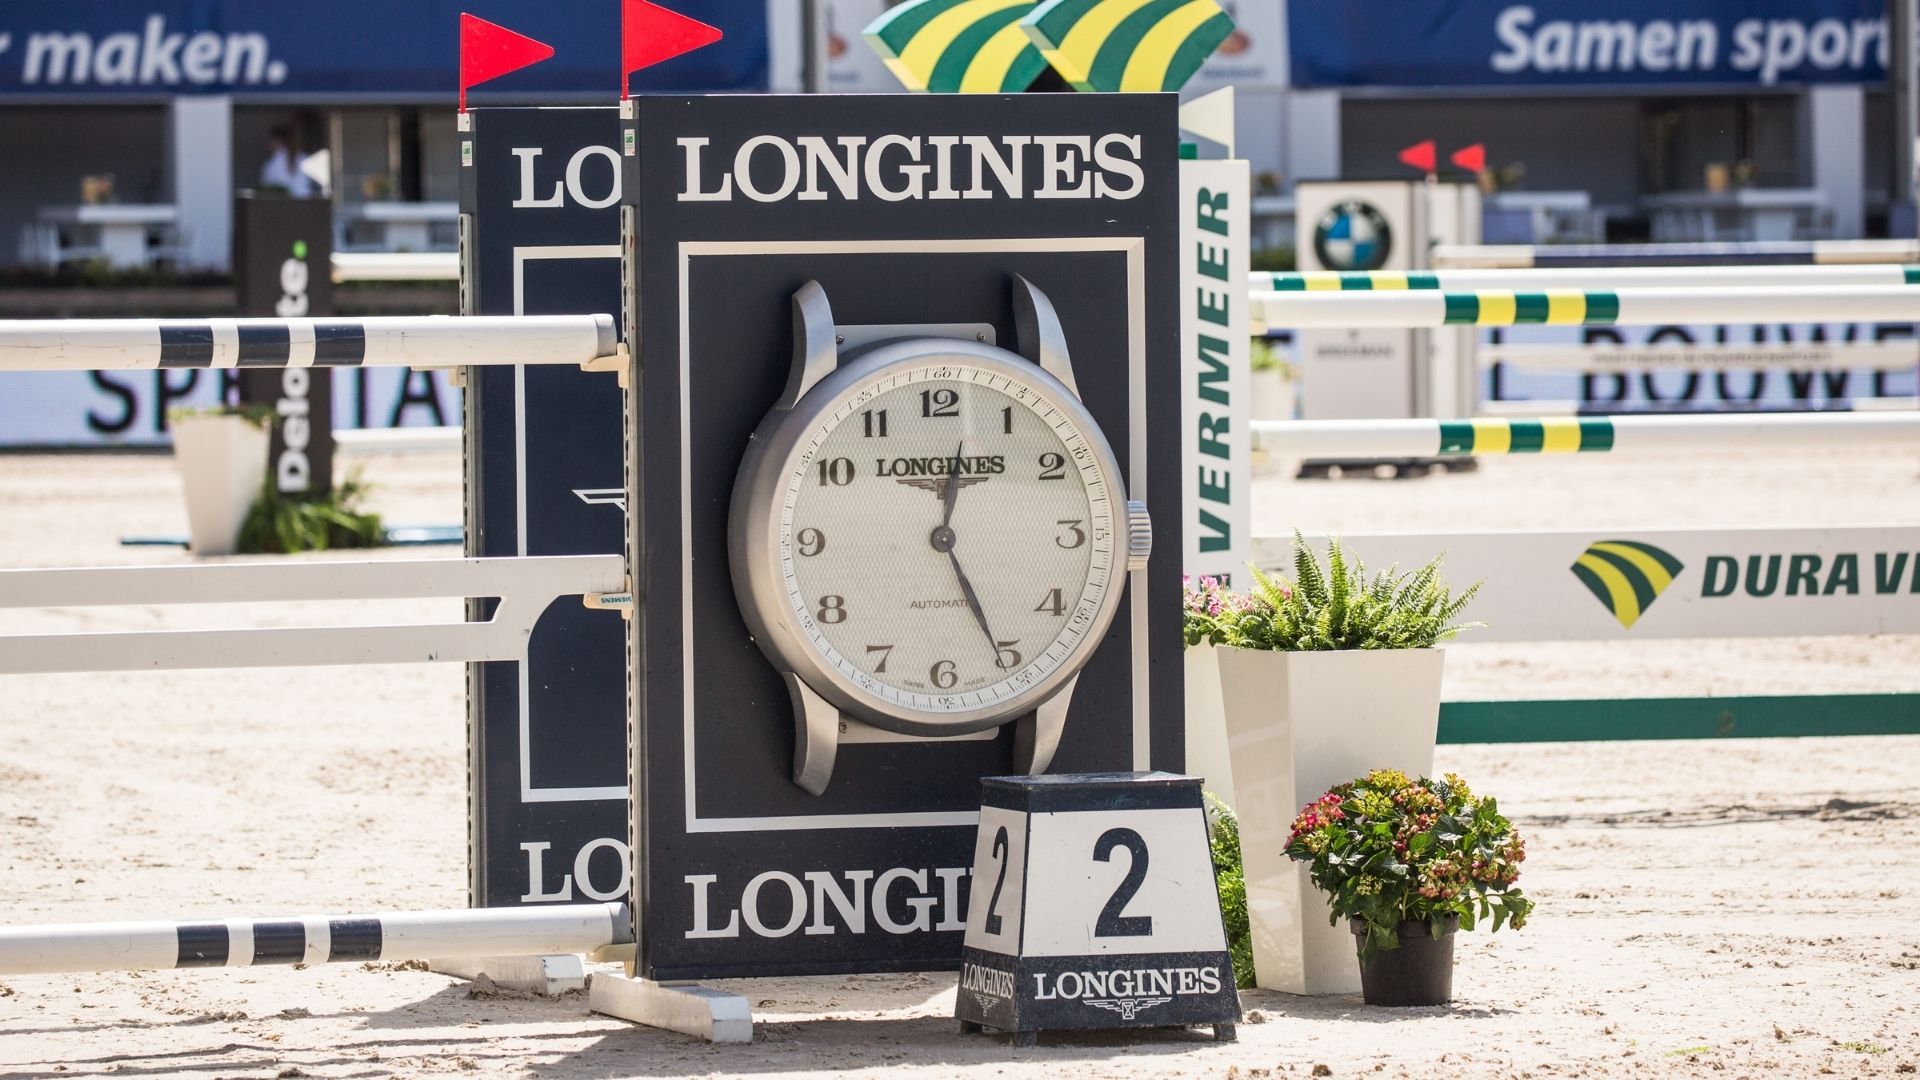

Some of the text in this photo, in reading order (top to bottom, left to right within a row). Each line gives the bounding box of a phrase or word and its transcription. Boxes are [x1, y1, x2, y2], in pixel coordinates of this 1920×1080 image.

[22, 14, 288, 84] maken.
[1491, 5, 1718, 72] Samen
[676, 133, 1145, 203] LONGINES
[276, 240, 310, 492] Delote.
[1197, 187, 1231, 553] VERMEER
[919, 388, 960, 418] 12
[861, 408, 888, 438] 11
[1001, 406, 1013, 434] 1
[816, 457, 856, 487] 10
[876, 455, 1006, 478] LONGINES
[1038, 452, 1066, 481] 2
[797, 527, 826, 557] 9
[1055, 519, 1086, 550] 3
[1701, 553, 1860, 598] DURA
[816, 594, 848, 625] 8
[910, 599, 970, 609] AUTOMATI
[1033, 588, 1068, 617] 4
[866, 644, 894, 674] 7
[995, 639, 1022, 669] 5
[929, 659, 959, 690] 6
[984, 825, 1009, 936] 2
[1092, 826, 1153, 938] 2
[684, 866, 973, 940] LONGI
[962, 962, 1015, 1000] LONGINES
[1033, 966, 1222, 1000] LONGINES
